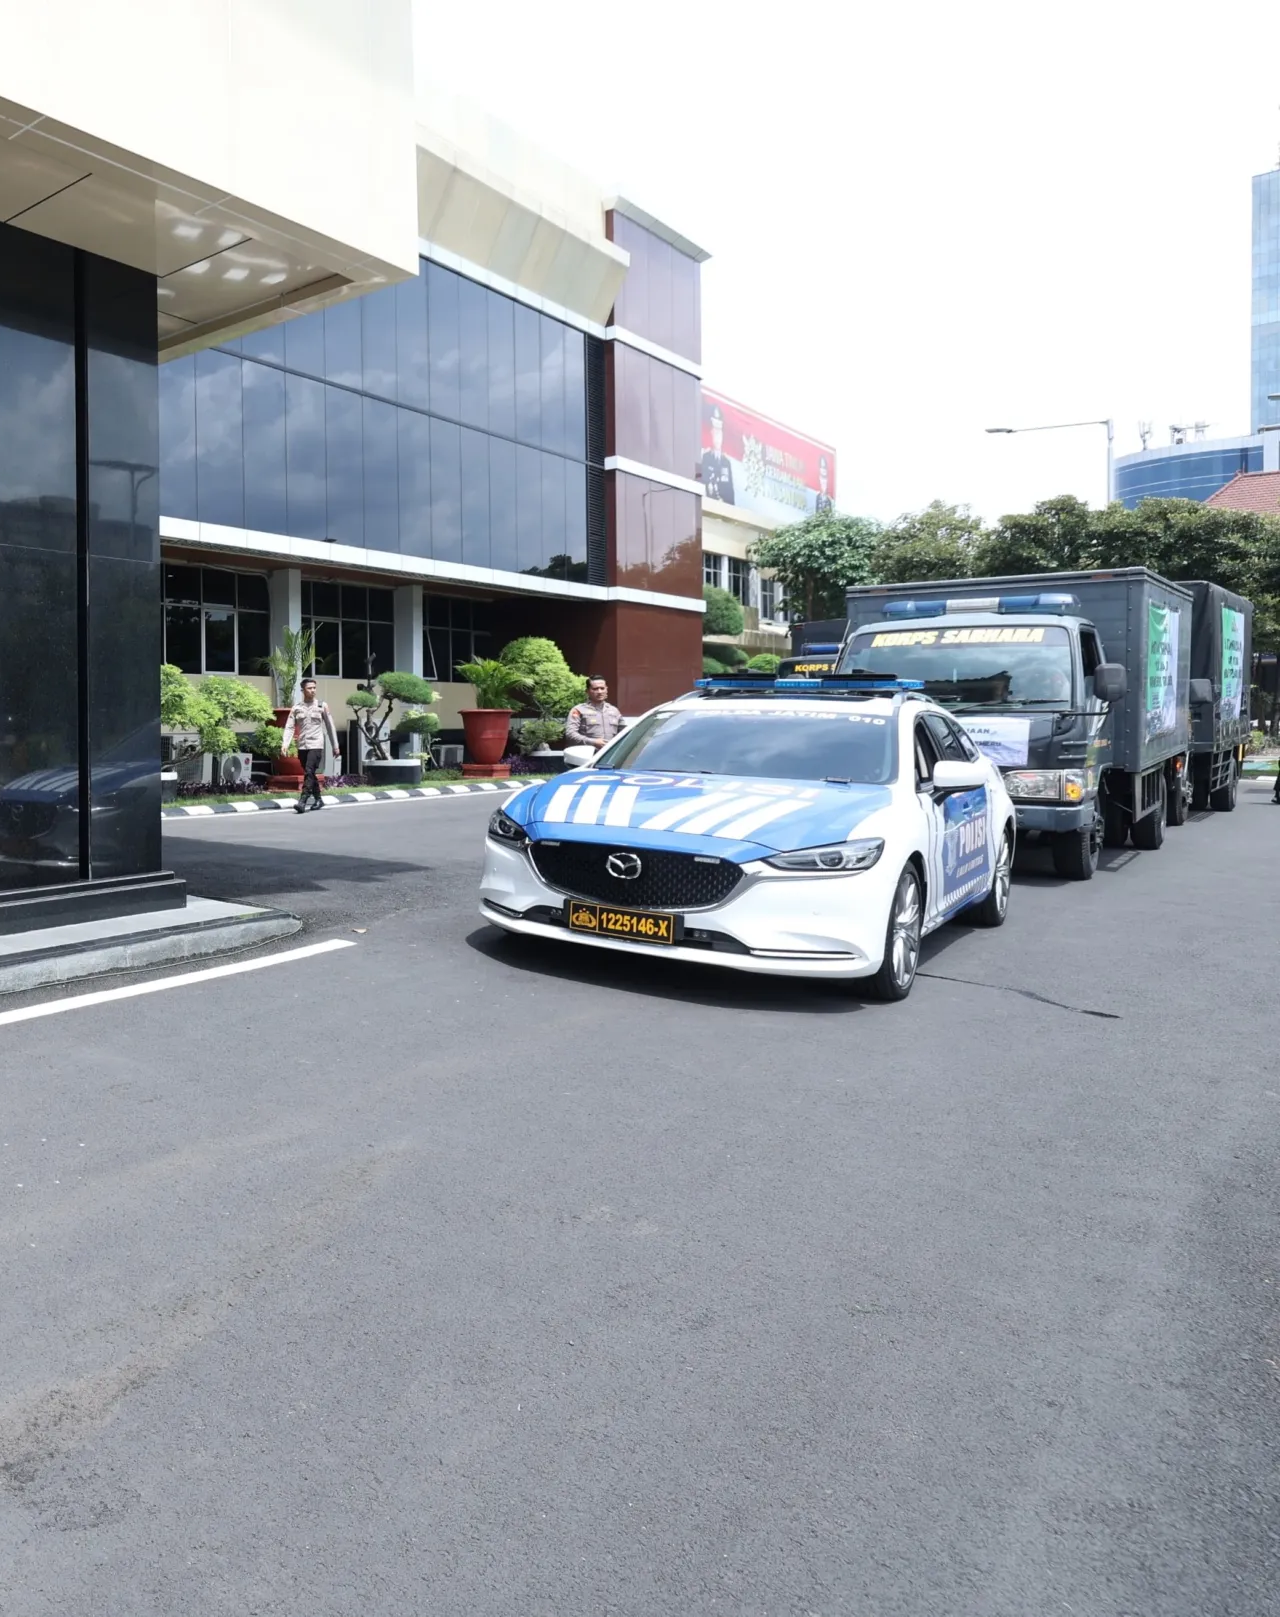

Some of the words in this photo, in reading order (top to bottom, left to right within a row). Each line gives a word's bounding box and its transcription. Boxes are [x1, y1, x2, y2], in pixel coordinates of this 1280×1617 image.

[871, 630, 939, 647] KORPS
[940, 628, 1045, 644] SABHARA
[794, 663, 829, 672] KORPS
[768, 711, 838, 720] JATIM
[848, 715, 886, 726] 010
[572, 775, 821, 799] POLISI
[959, 815, 986, 858] POLISI
[600, 911, 669, 937] 1225146-X
